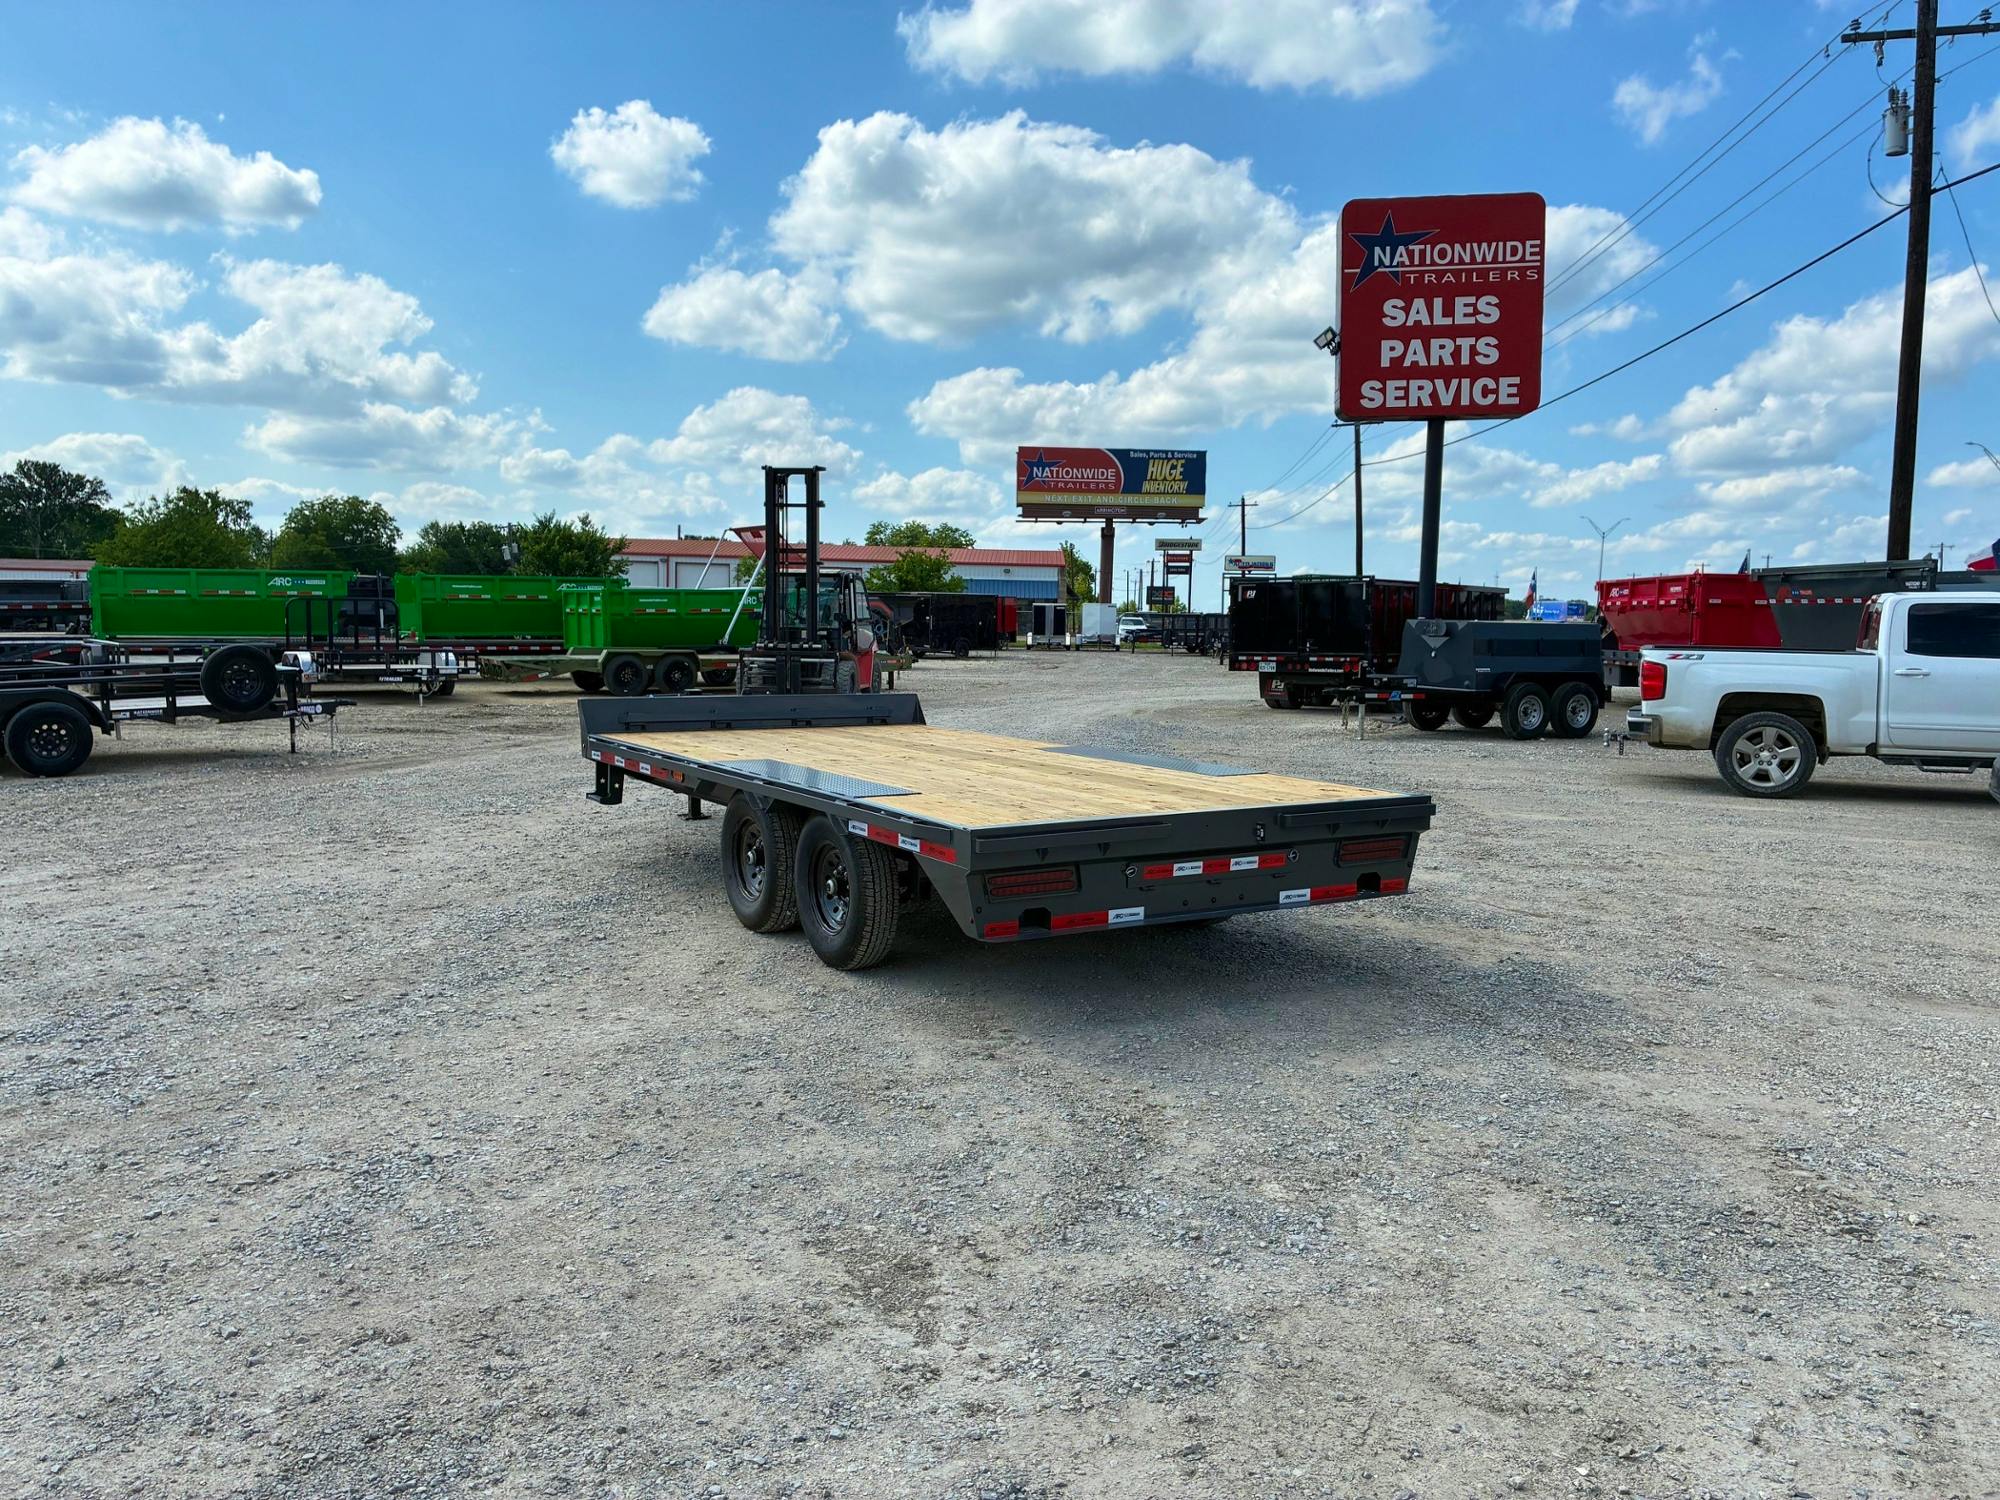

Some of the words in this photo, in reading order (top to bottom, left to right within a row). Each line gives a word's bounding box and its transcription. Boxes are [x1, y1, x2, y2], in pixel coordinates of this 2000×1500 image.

[1374, 240, 1541, 266] NATIONWIDE
[1405, 270, 1538, 285] TRAILERS
[1382, 296, 1500, 327] SALES
[1380, 336, 1499, 368] PARTS
[1360, 376, 1520, 409] SERVICE
[1033, 466, 1116, 480] NATIONWIDE
[1146, 459, 1185, 480] HUGE
[1141, 481, 1188, 494] INVENTORY!
[1044, 495, 1070, 503] NEXT
[1119, 496, 1150, 504] CIRCLE
[268, 577, 292, 586] ARC
